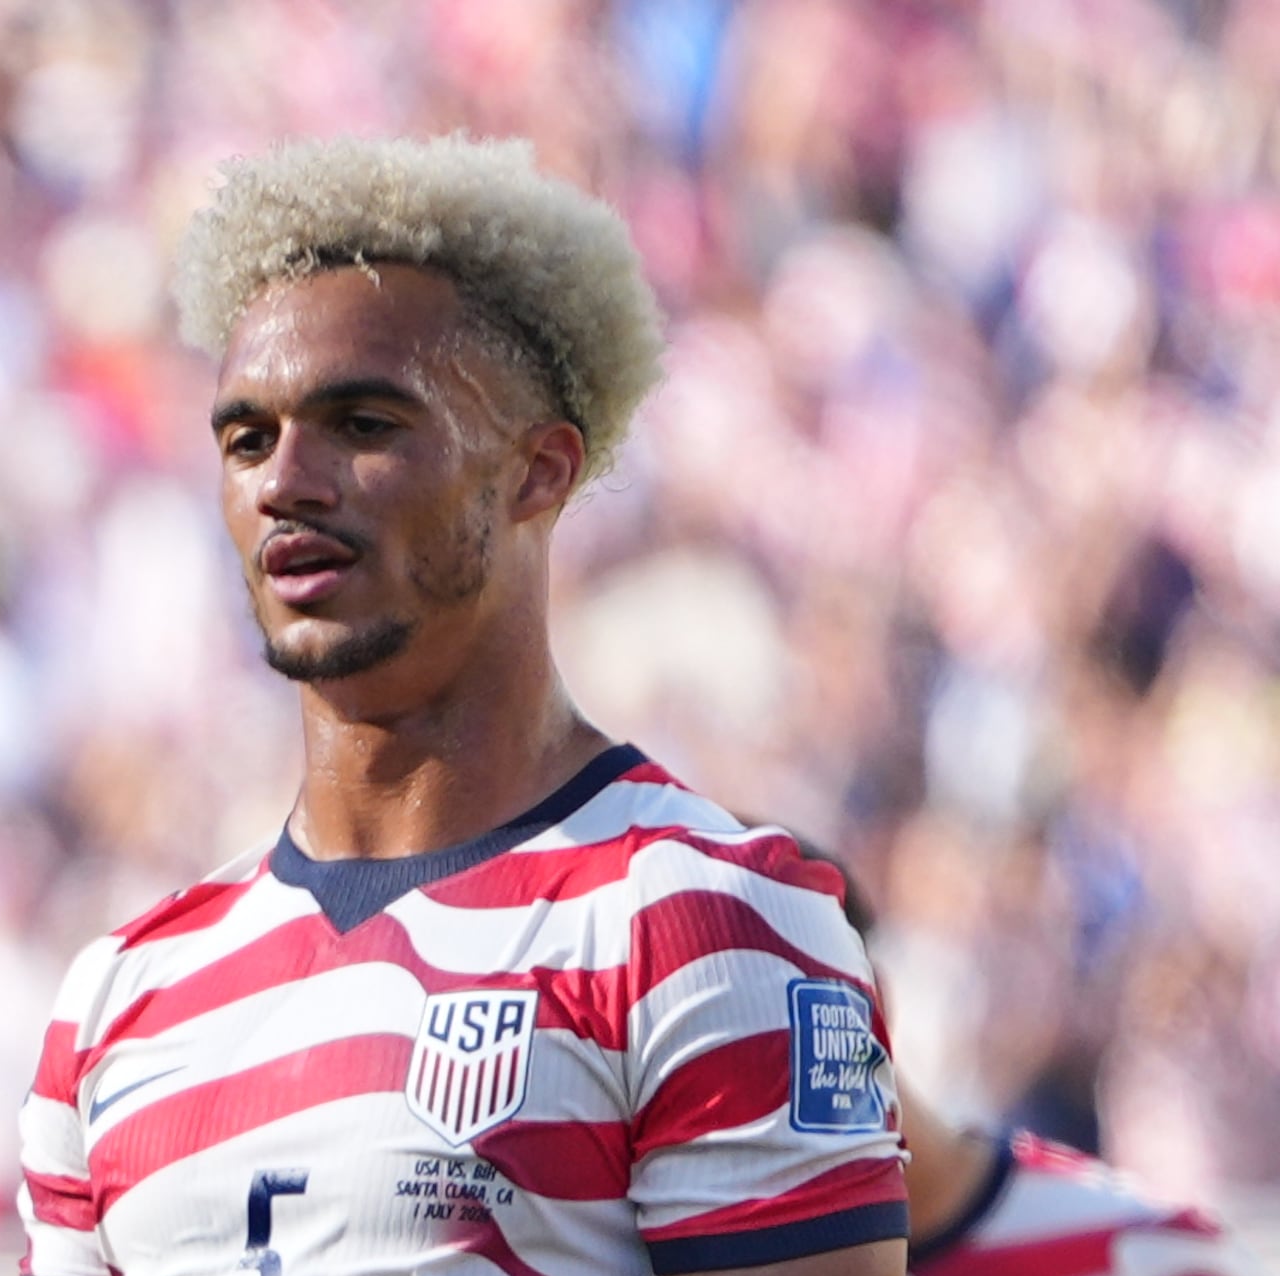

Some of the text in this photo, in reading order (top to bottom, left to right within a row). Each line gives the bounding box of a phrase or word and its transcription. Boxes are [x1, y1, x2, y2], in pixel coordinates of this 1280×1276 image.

[427, 1000, 526, 1054] USA
[811, 1003, 864, 1029] FOOTB
[414, 1159, 440, 1177] USA
[395, 1180, 439, 1198] SANTA
[496, 1188, 515, 1206] CA
[424, 1203, 456, 1219] JULY
